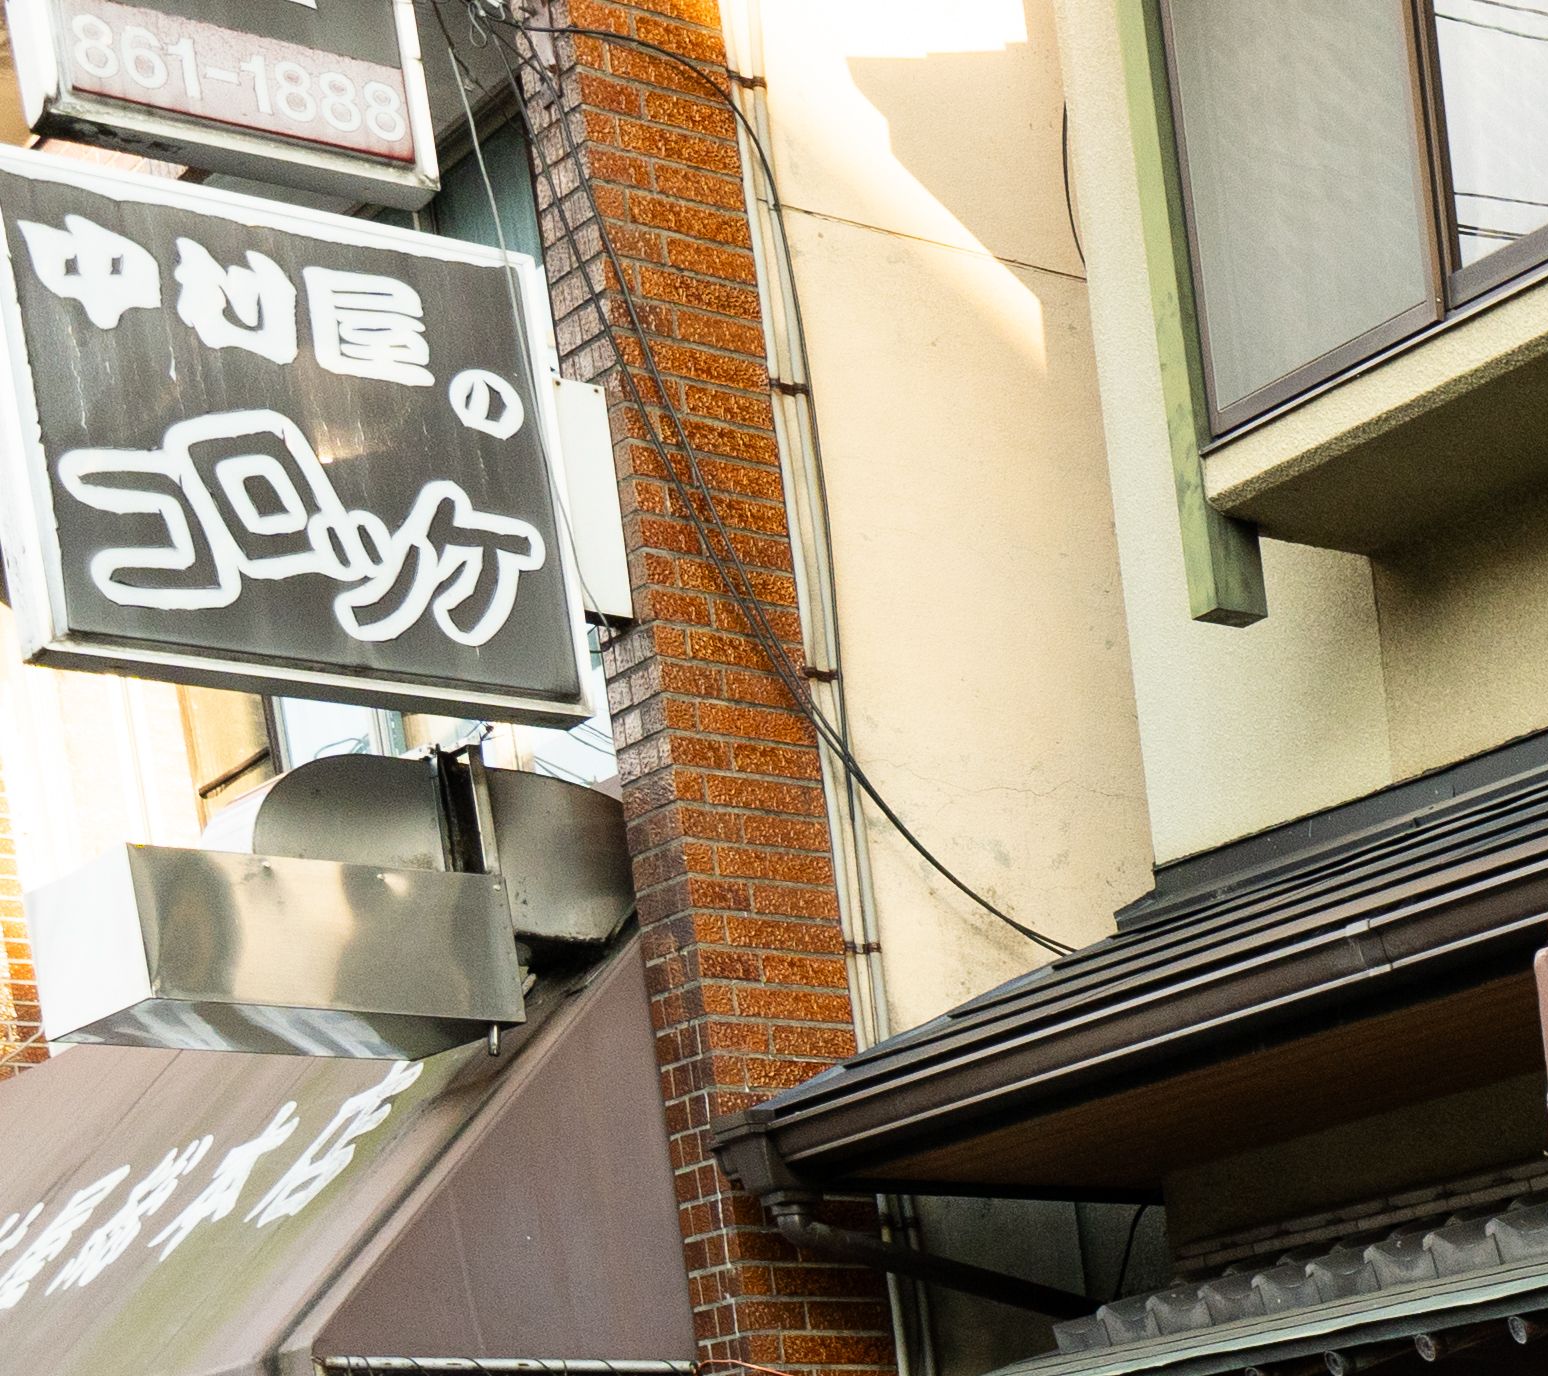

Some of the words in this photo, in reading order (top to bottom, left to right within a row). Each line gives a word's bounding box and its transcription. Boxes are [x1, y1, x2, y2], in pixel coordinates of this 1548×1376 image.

[70, 14, 408, 145] 861-1888
[19, 214, 525, 441] 中村屋の
[56, 409, 546, 648] コロッケ
[0, 1060, 424, 1311] 屋総本店
